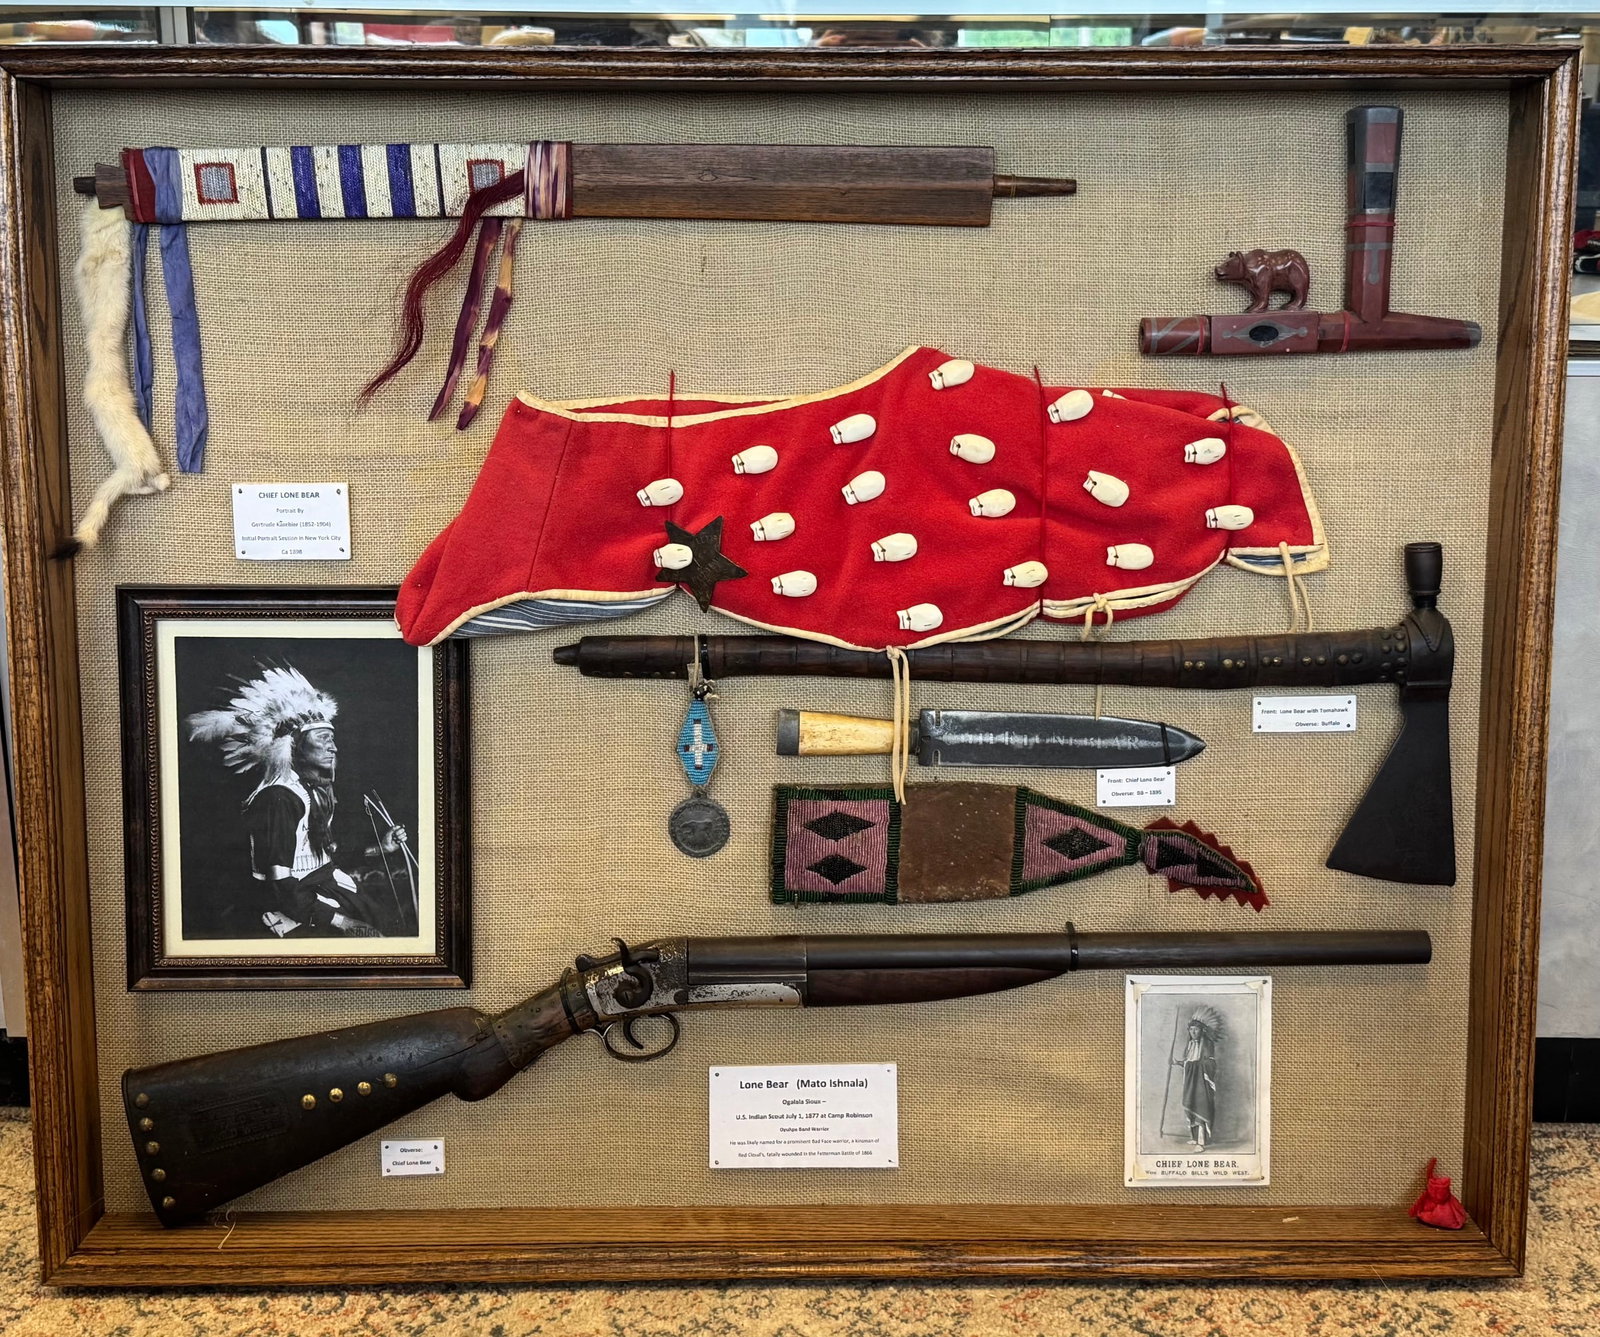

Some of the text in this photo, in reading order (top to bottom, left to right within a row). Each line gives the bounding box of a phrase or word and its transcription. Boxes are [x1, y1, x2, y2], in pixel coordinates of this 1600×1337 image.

[259, 491, 319, 499] CHIEF LONE BEAR
[739, 1078, 868, 1090] Lone Bear (Mato Ishnala)
[785, 1113, 797, 1121] July
[827, 1112, 844, 1120] Camp
[1156, 1160, 1239, 1168] CHIEF LONE BEAR.
